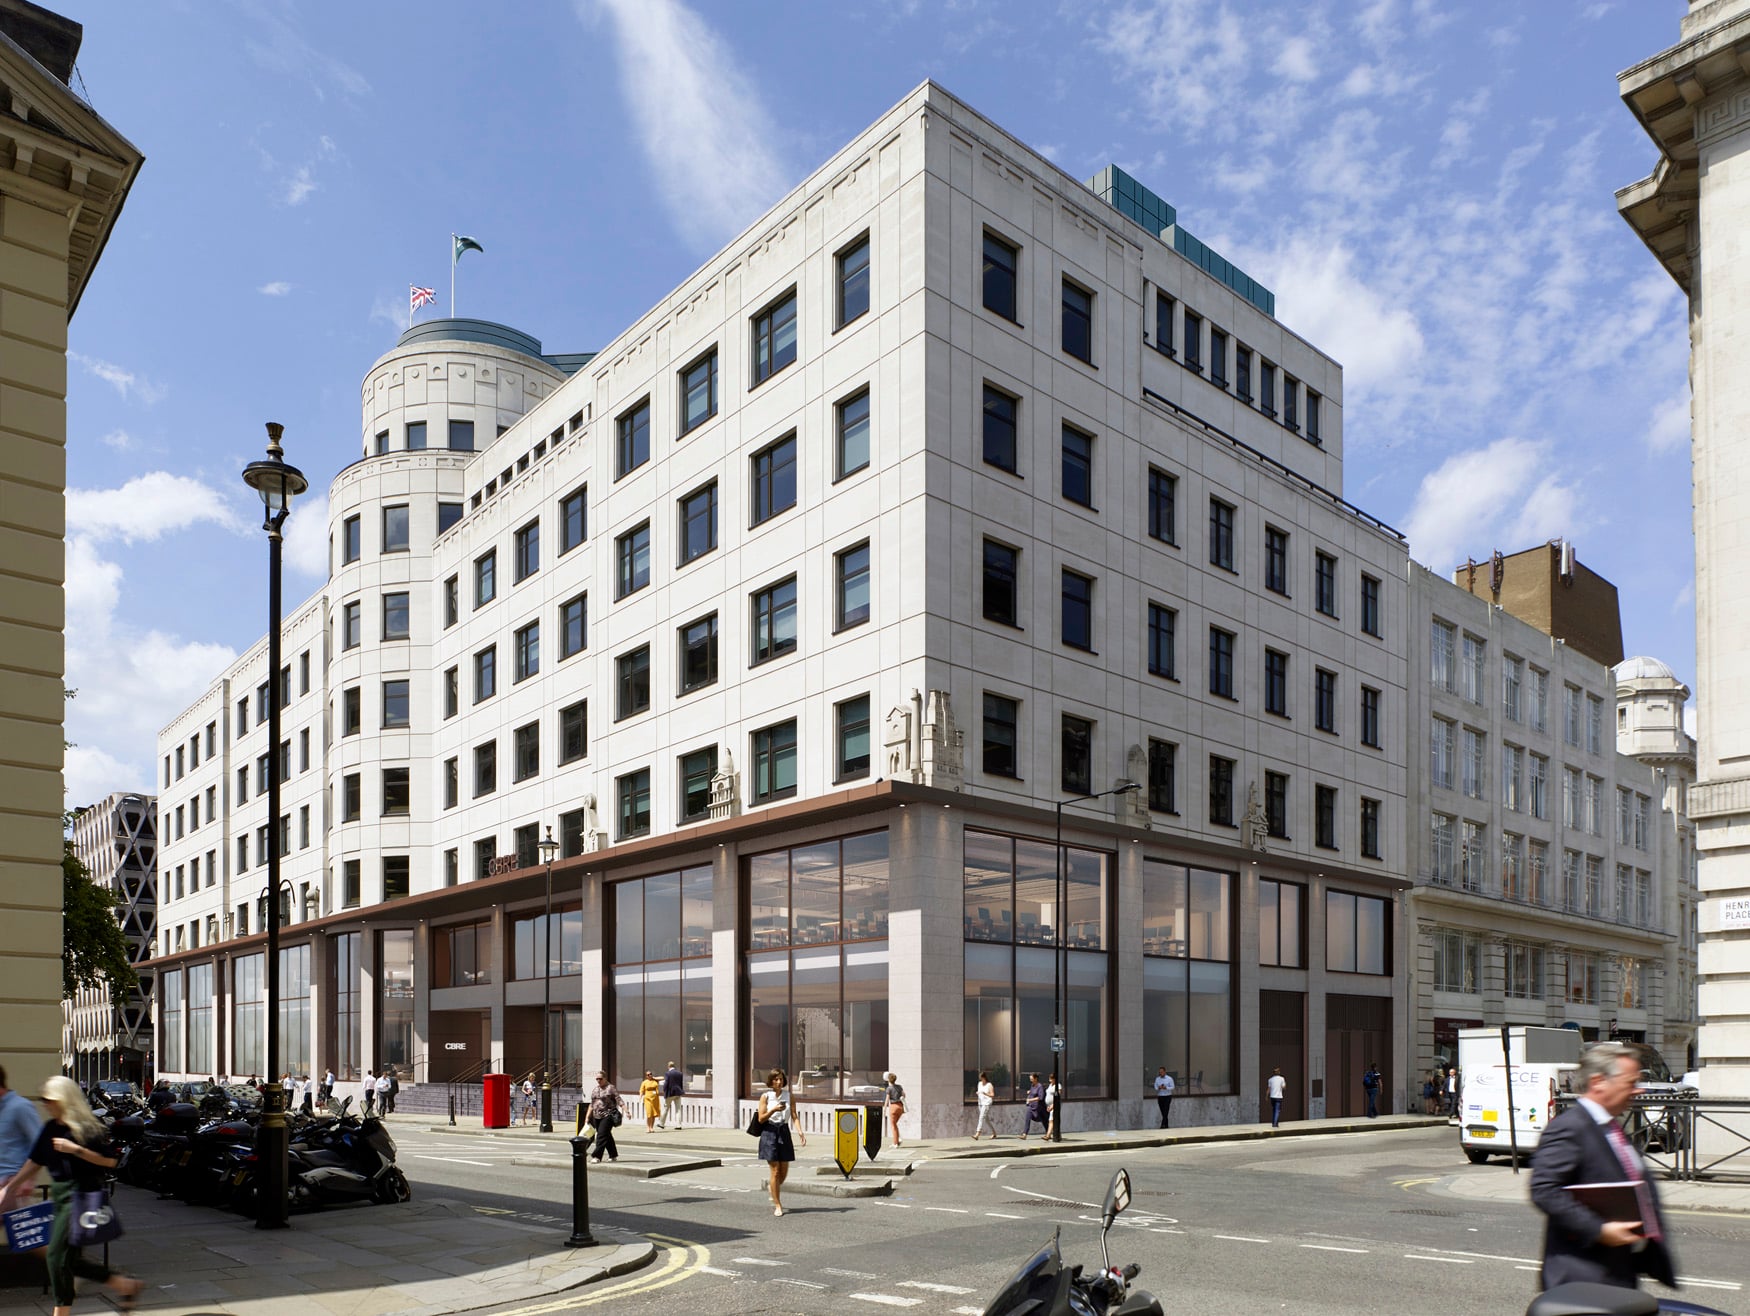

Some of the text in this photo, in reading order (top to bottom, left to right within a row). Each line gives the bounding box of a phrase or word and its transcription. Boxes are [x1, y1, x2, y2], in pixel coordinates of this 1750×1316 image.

[488, 853, 518, 875] CBRE
[445, 1042, 466, 1050] CBRE
[18, 1236, 44, 1248] SALE
